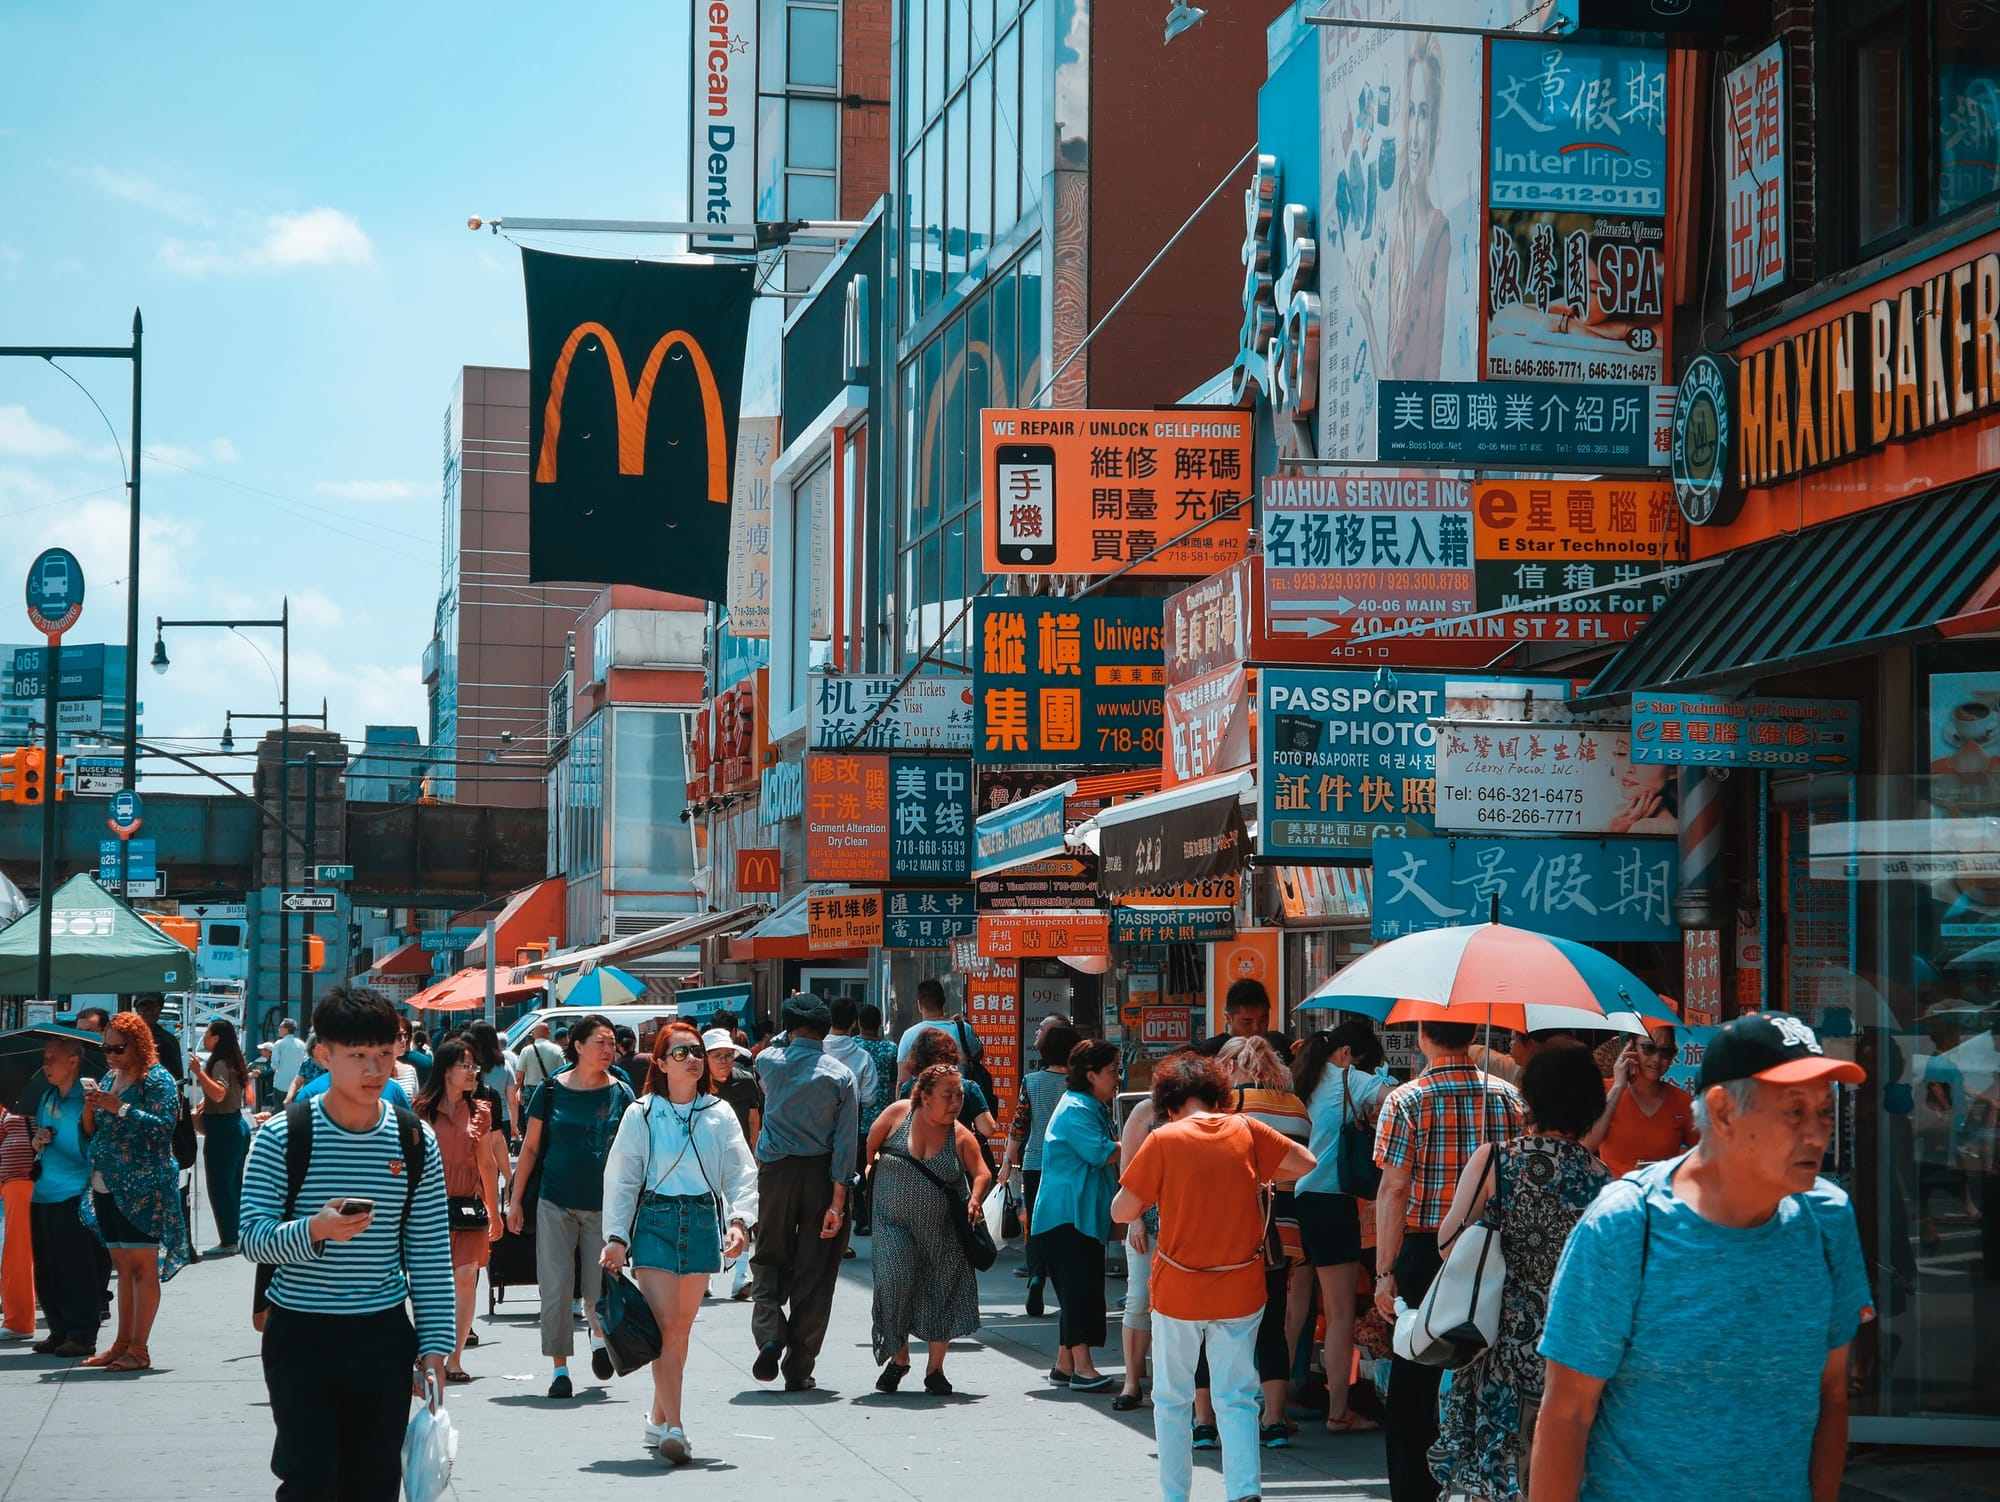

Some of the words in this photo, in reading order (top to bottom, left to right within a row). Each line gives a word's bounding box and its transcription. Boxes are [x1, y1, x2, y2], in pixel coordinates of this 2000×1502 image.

[708, 0, 729, 116] erican
[1495, 49, 1666, 136] 文景假期
[1728, 58, 1779, 180] 信箱
[1496, 185, 1658, 204] 718-412-0111
[1632, 223, 1663, 242] Yuan
[1732, 176, 1781, 293] 出租
[1597, 243, 1661, 315] SPA
[1631, 329, 1654, 348] 3B
[1490, 357, 1512, 374] TEL:
[1515, 358, 1586, 381] 646-266-7771,
[1589, 362, 1657, 381] 646-321-6475
[1739, 312, 1856, 490] MAXIN
[1870, 253, 2000, 446] BAKER
[1394, 392, 1641, 435] 美國職業介紹所
[1675, 371, 1698, 461] MAXIN
[1699, 364, 1729, 448] BAKERY
[992, 420, 1015, 436] WE
[1021, 421, 1074, 436] REPAIR
[1090, 421, 1149, 437] UNLOCK
[1154, 423, 1241, 439] CELLPHONE
[1391, 440, 1463, 450] www.Bosslook.Net
[1501, 443, 1517, 451] Main
[1556, 443, 1571, 453] Tel:
[1090, 446, 1158, 480] 維修
[1174, 447, 1241, 481] 解碼
[1266, 480, 1340, 507] JIAHUA
[1345, 480, 1429, 507] SERVICE
[1435, 481, 1470, 507] INC
[1009, 468, 1043, 538] 手機
[1175, 488, 1242, 522] 充值
[747, 433, 772, 601] 专业瘦身
[1092, 529, 1158, 563] 買賣
[1219, 538, 1239, 549] #H2
[1266, 513, 1469, 567] 名扬移民入籍
[1499, 538, 1510, 551] E
[1516, 538, 1555, 552] Star
[1560, 538, 1668, 556] Technology
[1168, 551, 1239, 562] 718-581-6677
[1271, 577, 1290, 590] TEL:
[1293, 572, 1376, 590] 929.329.0370
[1388, 572, 1470, 591] 929.300.8788
[1358, 600, 1401, 612] 40-06
[1406, 600, 1447, 612] MAIN
[1452, 600, 1472, 612] ST
[1501, 594, 1550, 612] Mail
[1558, 594, 1601, 612] Box
[1608, 594, 1645, 612] For
[31, 607, 41, 624] NO
[41, 606, 78, 631] STANDING
[1351, 617, 1427, 637] 40-06
[1435, 618, 1505, 637] MAIN
[1513, 618, 1547, 637] ST
[1555, 618, 1570, 637] 2
[1578, 618, 1610, 638] FL
[983, 611, 1082, 676] 縱橫
[1331, 647, 1390, 657] 40-10
[1109, 668, 1165, 683] 美東商
[816, 678, 901, 716] 机票
[904, 681, 916, 697] Air
[918, 681, 946, 697] Tickets
[904, 698, 923, 714] Visas
[1270, 686, 1438, 714] PASSPORT
[1651, 701, 1676, 714] Star
[1681, 701, 1748, 718] Technology
[984, 687, 1081, 751] 集團
[904, 721, 941, 737] Tours
[1329, 720, 1438, 746] PHOTO
[1096, 728, 1165, 752] 718-80
[1273, 751, 1302, 765] FOTO
[1305, 751, 1370, 767] PASAPORTE
[1379, 753, 1436, 770] 여권사진
[1636, 747, 1810, 764] 718.321.8808
[811, 758, 861, 785] 修改
[1466, 761, 1504, 775] Cherry
[1508, 762, 1546, 775] Facial
[896, 766, 964, 800] 美中
[1274, 772, 1437, 815] 証件快照
[1444, 785, 1472, 801] Tel:
[1478, 786, 1584, 804] 646-321-6475
[811, 793, 861, 820] 干洗
[896, 802, 965, 836] 快线
[1478, 808, 1582, 825] 646-266-7771
[810, 823, 845, 834] Garment
[847, 822, 886, 834] Alteration
[1287, 822, 1367, 837] 美東地面店
[828, 836, 843, 847] Dry
[844, 837, 868, 847] Clean
[896, 840, 966, 855] 718-668-5593
[1288, 836, 1316, 845] EAST
[1321, 837, 1350, 845] MALL
[325, 868, 337, 878] 40
[896, 859, 918, 872] 40-12
[920, 859, 940, 872] MAIN
[942, 859, 953, 872] ST.
[1060, 864, 1073, 872] S3
[1385, 846, 1672, 927] 文景假期
[289, 898, 305, 906] ONE
[312, 898, 328, 906] WAY
[810, 898, 878, 921] 手机维修
[989, 917, 1021, 927] Phone
[1024, 917, 1073, 928] Tempered
[1076, 917, 1104, 926] Glass
[1118, 912, 1185, 925] PASSPORT
[1188, 911, 1232, 924] PHOTO
[811, 923, 842, 939] Phone
[846, 921, 881, 938] Repair
[989, 930, 1012, 941] 手机
[1023, 930, 1068, 948] 贴膜
[1119, 926, 1195, 942] 証件快照
[907, 938, 950, 947] 718-321
[989, 942, 1012, 952] iPad
[212, 951, 234, 961] NYPD
[993, 963, 1017, 978] Deal
[973, 994, 1015, 1011] 百貨店
[971, 1015, 1016, 1025] 生活日用品
[1146, 1020, 1187, 1038] OPEN
